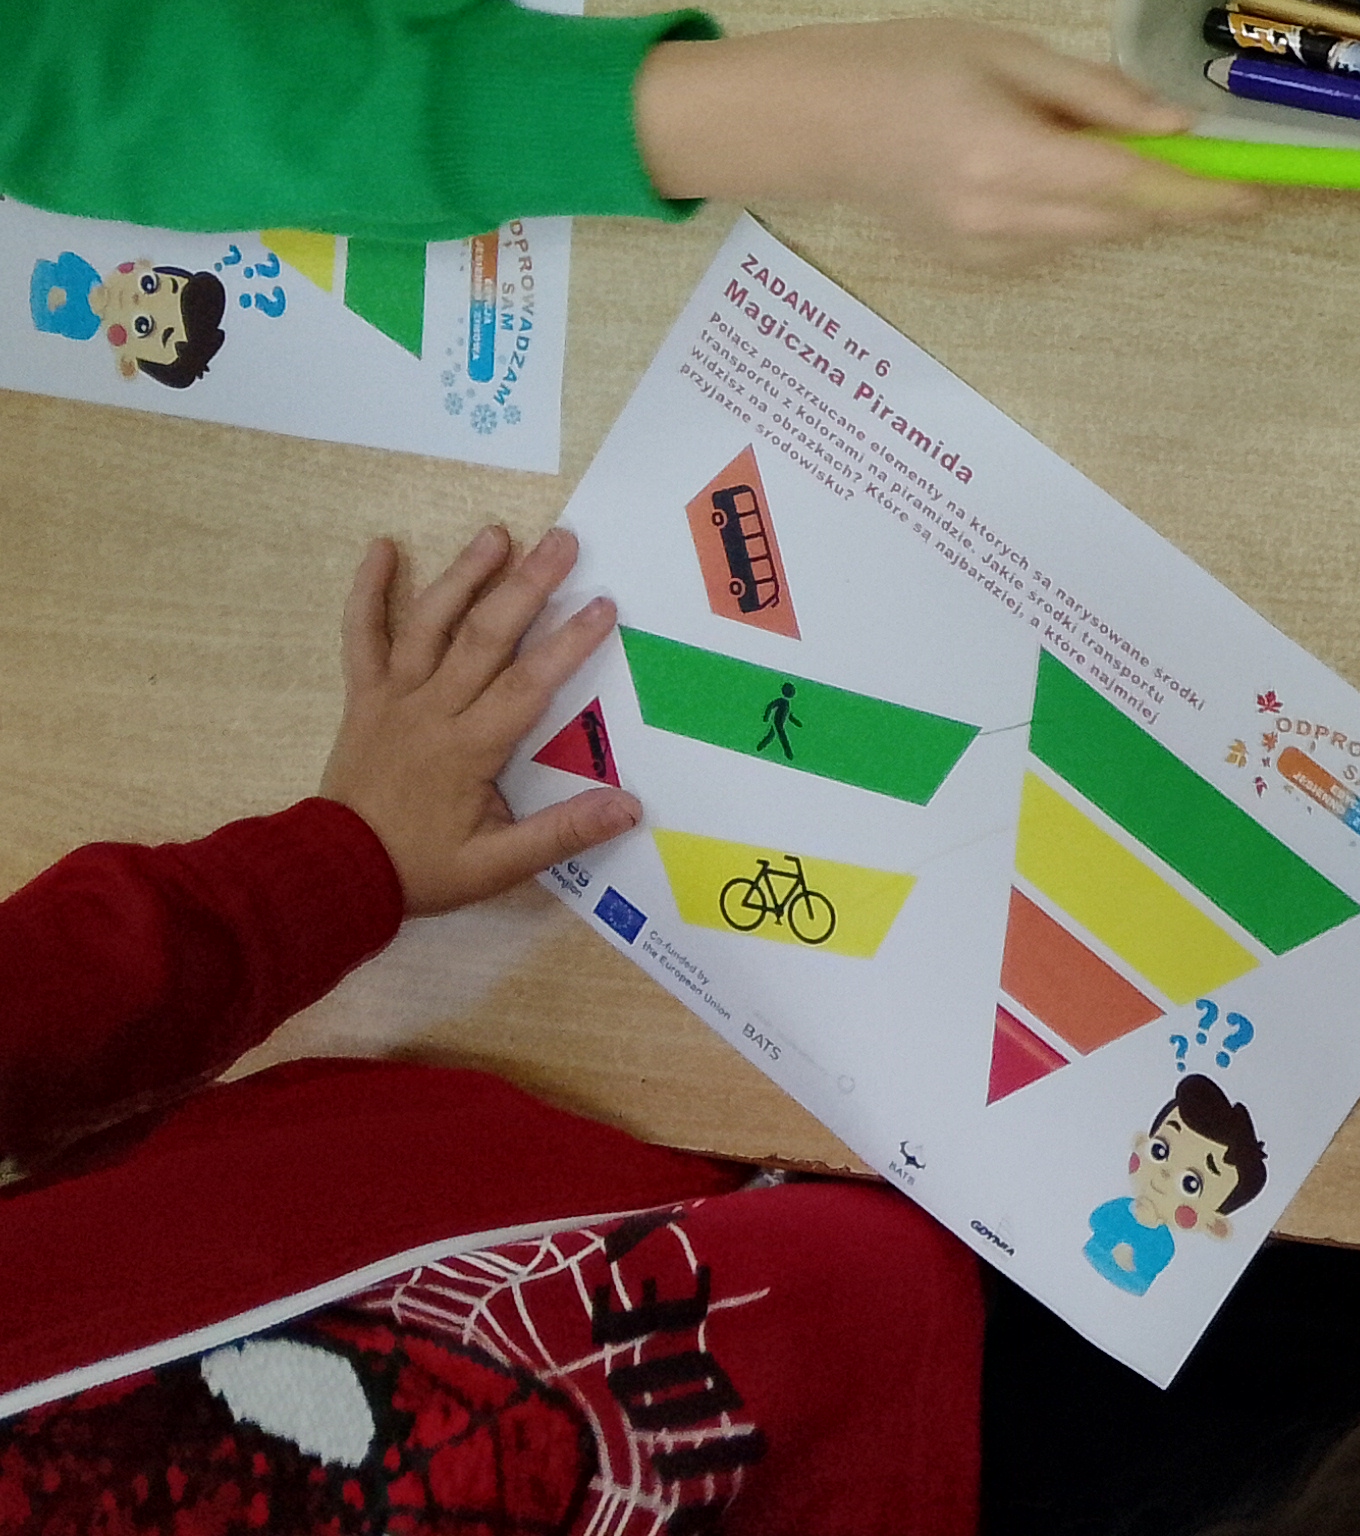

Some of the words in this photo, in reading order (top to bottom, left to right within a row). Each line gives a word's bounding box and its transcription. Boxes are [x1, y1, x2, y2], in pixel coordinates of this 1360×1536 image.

[492, 221, 536, 405] DPROWADZAM
[496, 281, 518, 331] SAM
[739, 252, 842, 341] ZADANIE
[842, 336, 871, 362] nr
[874, 358, 892, 378] 6
[678, 362, 753, 424] przyjazne
[722, 277, 846, 388] Magiczna
[852, 380, 974, 486] Piramida
[700, 328, 781, 400] transportu
[794, 403, 865, 465] kolorami
[866, 462, 889, 484] na
[888, 481, 976, 555] piramidzie.
[980, 552, 1025, 591] Jakie
[1080, 630, 1166, 705] transportu
[758, 356, 867, 442] porozrzucane
[869, 441, 944, 502] elementy
[945, 499, 967, 521] na
[1031, 569, 1053, 591] są
[1054, 587, 1151, 667] narysowane
[641, 939, 659, 960] the
[657, 954, 704, 996] European
[702, 991, 732, 1022] Union
[696, 968, 711, 987] by
[741, 1021, 783, 1062] BATS
